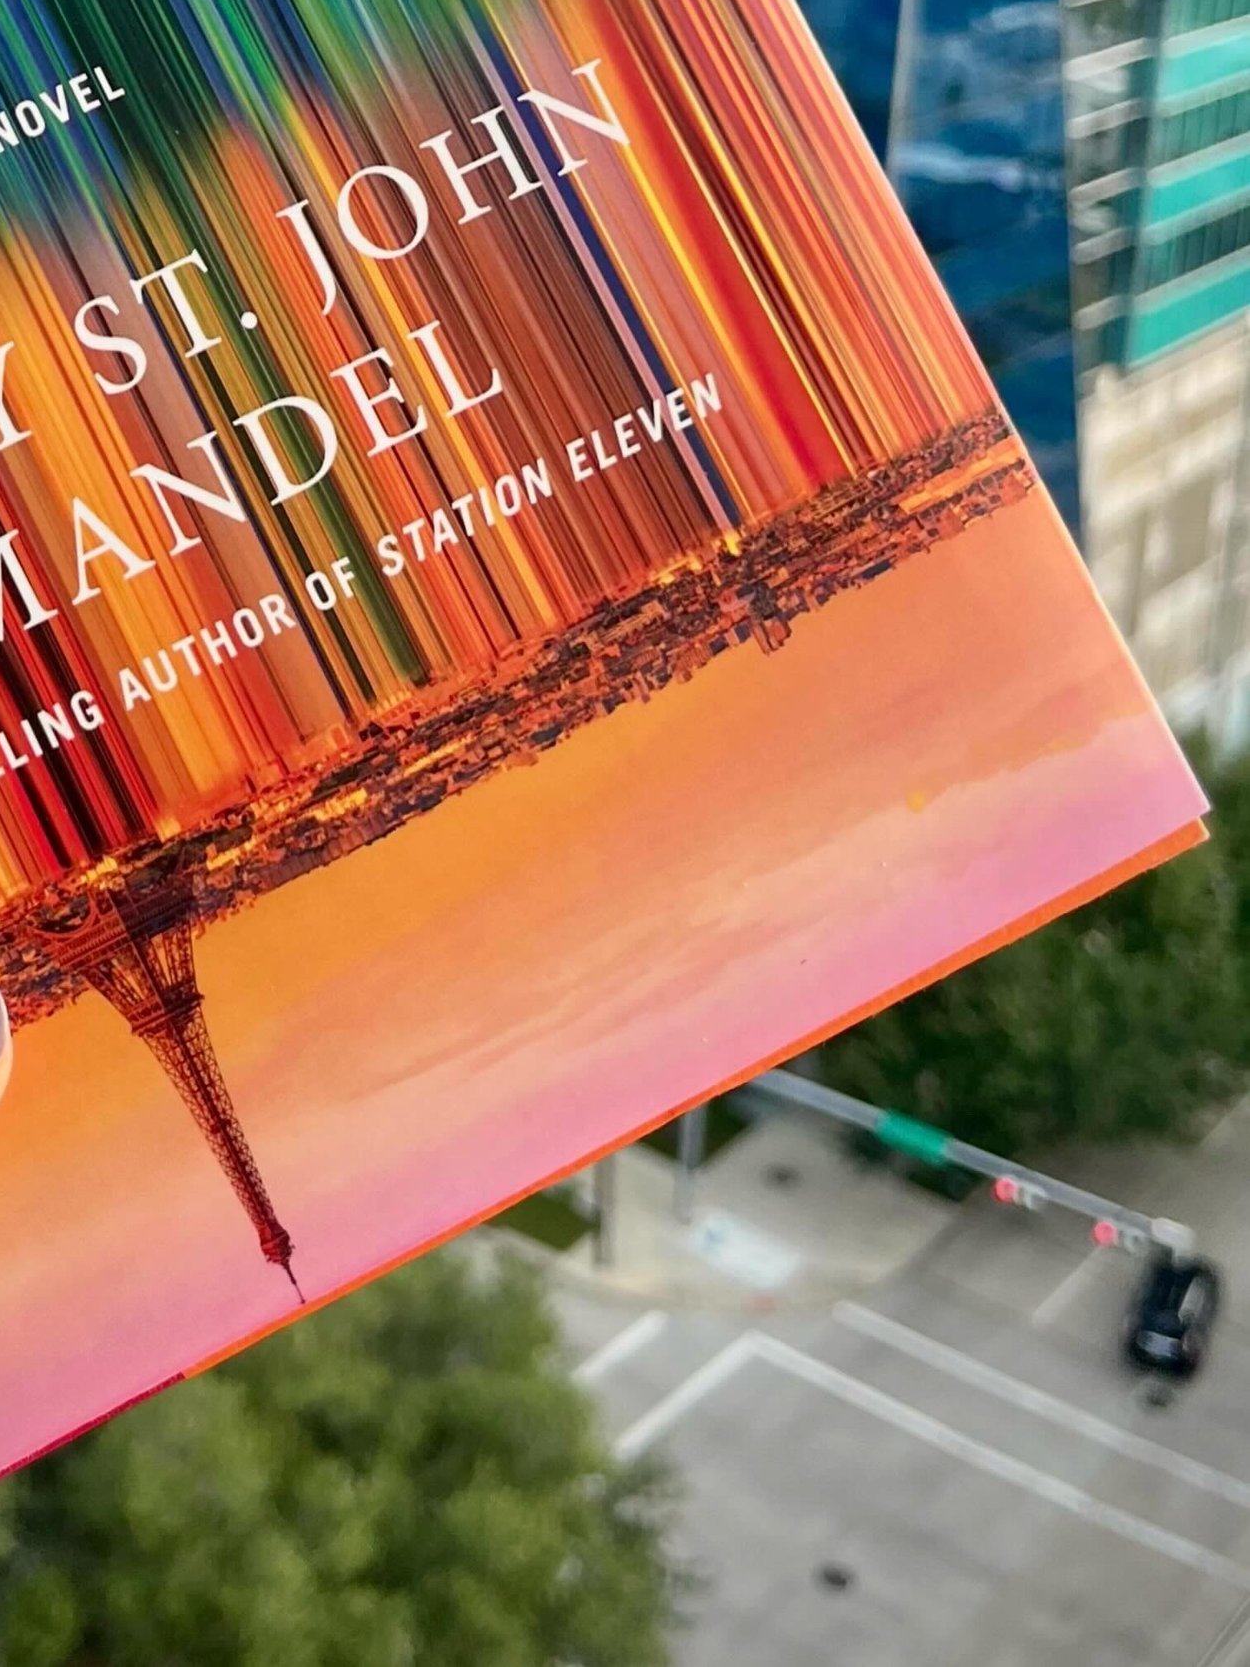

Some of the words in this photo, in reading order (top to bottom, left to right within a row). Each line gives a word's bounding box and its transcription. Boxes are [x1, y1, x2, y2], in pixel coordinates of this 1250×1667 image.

[74, 250, 259, 395] ST.
[276, 58, 636, 314] JOHN
[117, 592, 296, 714] AUTHOR
[307, 556, 358, 612] OF
[378, 454, 553, 578] STATION
[568, 373, 722, 480] ELEVEN
